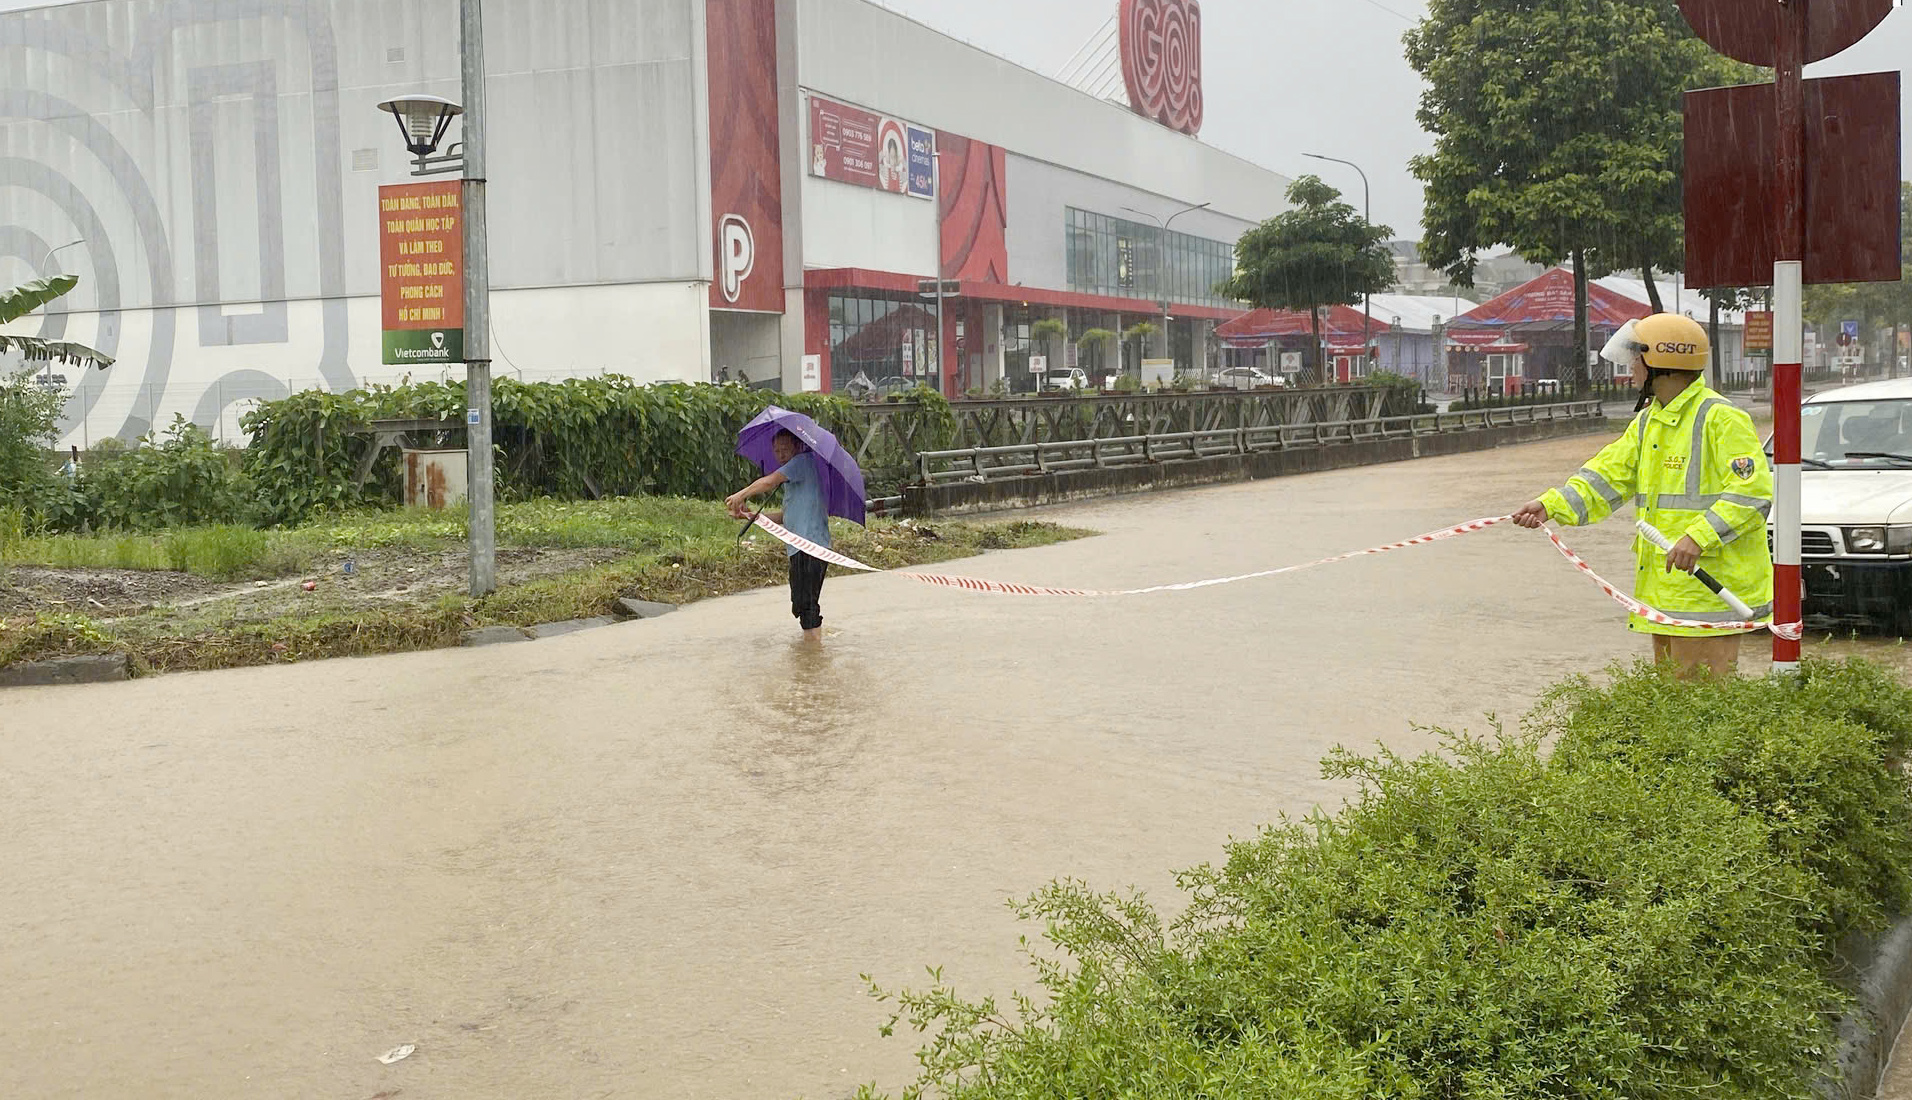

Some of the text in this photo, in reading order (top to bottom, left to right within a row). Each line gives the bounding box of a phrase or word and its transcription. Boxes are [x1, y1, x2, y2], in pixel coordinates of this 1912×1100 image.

[1131, 0, 1202, 132] GO!
[382, 192, 459, 212] TOÀN ĐẢNG, TOÀN DÂN,
[387, 214, 455, 234] TOÀN QUÂN HỌC TẬP
[399, 239, 443, 255] VÀ LÀM THEO
[721, 215, 753, 300] P
[388, 264, 398, 278] TƯ
[423, 263, 437, 278] ĐẠO
[400, 282, 444, 300] PHONG CÁCH
[398, 304, 408, 322] HỒ
[409, 305, 421, 321] CHÍ
[422, 307, 441, 321] MINH
[394, 346, 450, 358] Vietcombank
[1655, 341, 1697, 355] CSGT
